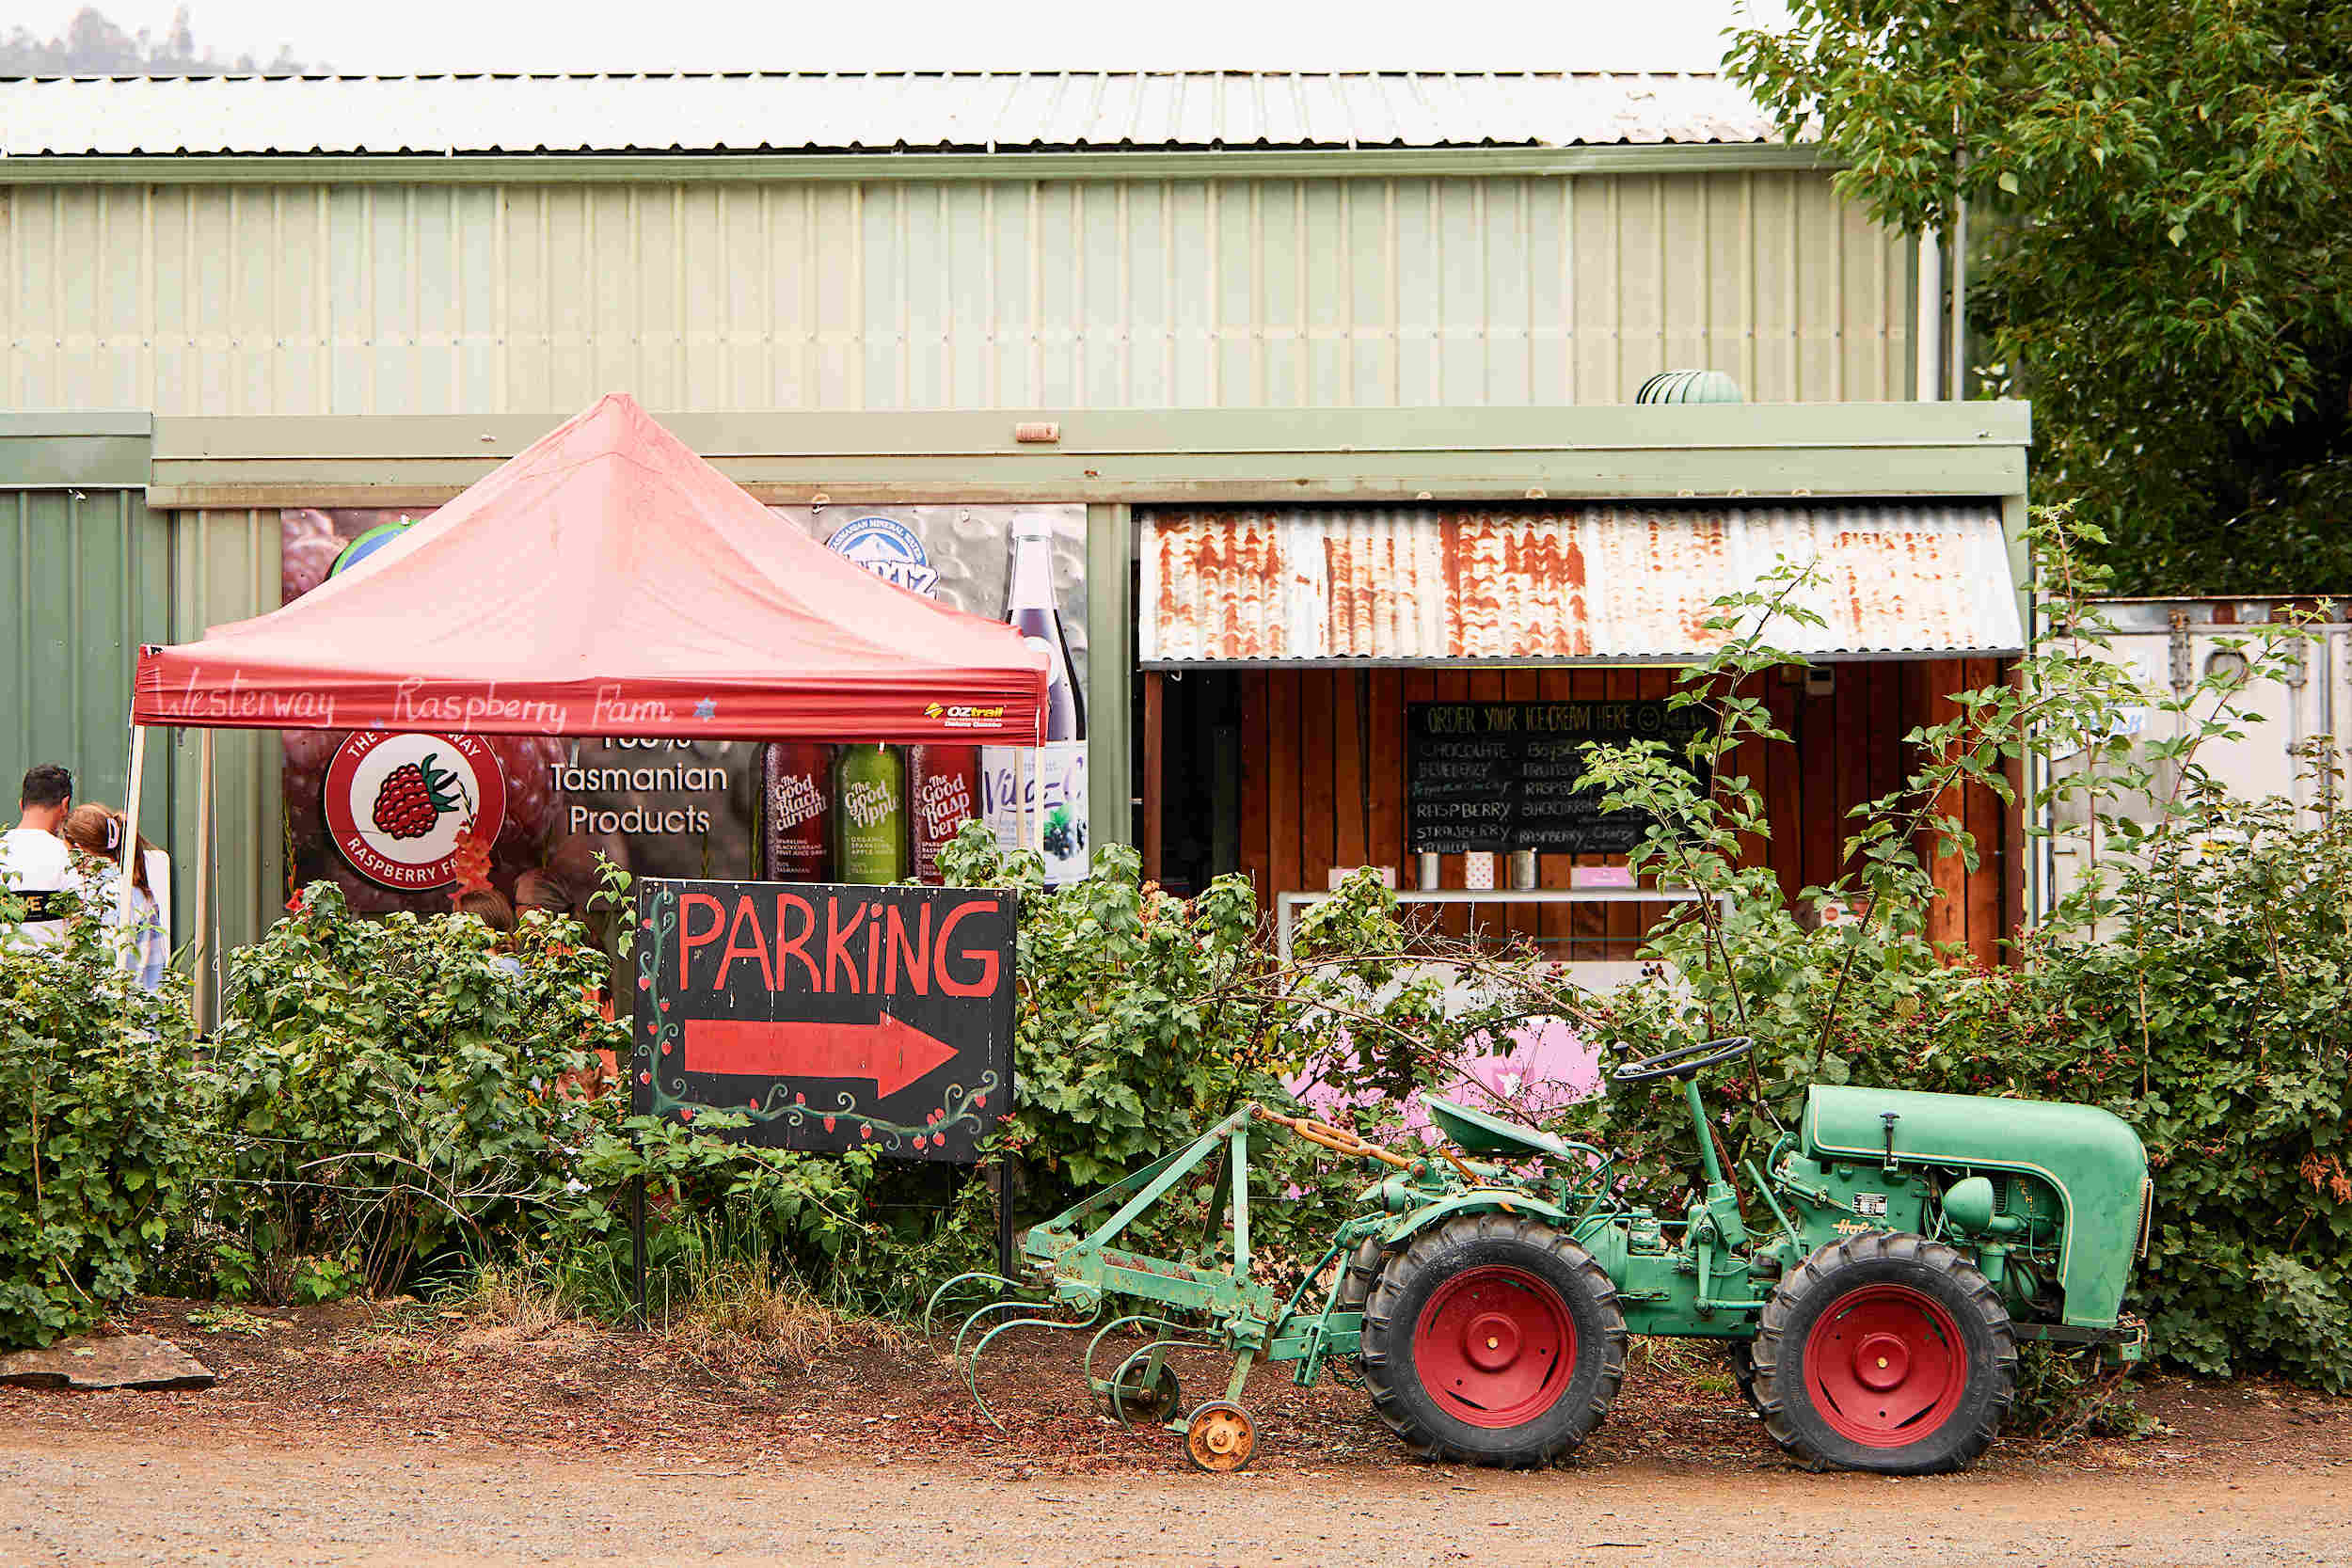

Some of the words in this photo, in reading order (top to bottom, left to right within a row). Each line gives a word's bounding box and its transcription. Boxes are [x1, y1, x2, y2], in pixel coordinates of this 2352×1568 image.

[154, 666, 335, 729] Westerway
[392, 675, 567, 736] Raspberry
[592, 683, 673, 730] Farm
[1485, 707, 1518, 731] YOUR
[346, 731, 378, 758] THE
[549, 762, 730, 791] Tasmanian
[774, 773, 815, 800] Good
[780, 774, 798, 787] The
[921, 772, 966, 803] Good
[929, 774, 948, 788] The
[844, 779, 889, 816] Good
[853, 792, 901, 828] Apple
[922, 792, 971, 824] Rasp
[1416, 801, 1513, 821] RASPBERRY
[570, 805, 711, 833] Products
[1415, 824, 1512, 842] STRAWBERRY
[346, 837, 437, 882] RASPBERRY
